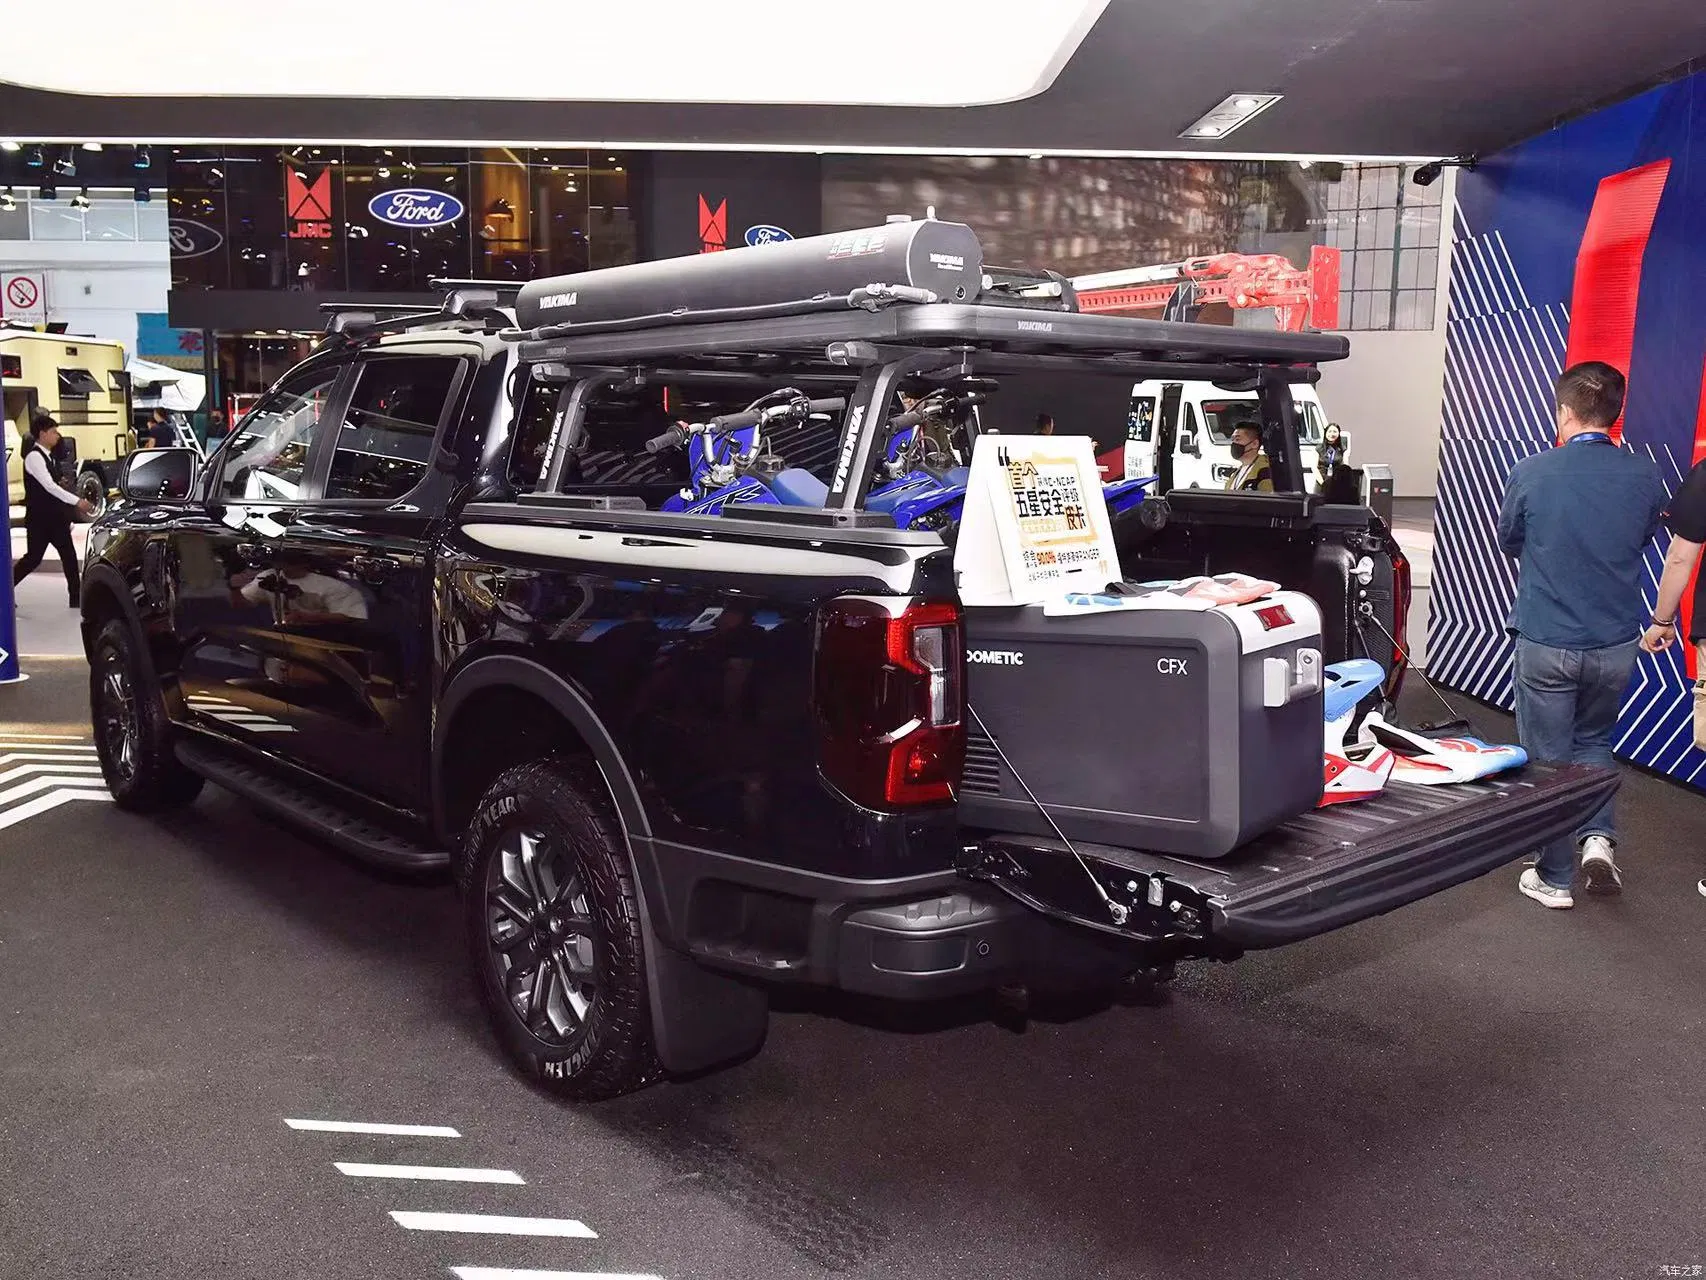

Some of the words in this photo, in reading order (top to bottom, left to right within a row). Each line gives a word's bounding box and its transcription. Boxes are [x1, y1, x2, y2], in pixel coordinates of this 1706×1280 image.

[386, 192, 446, 221] Ford
[289, 222, 332, 238] JMC
[539, 291, 578, 309] YAKIMA
[1017, 320, 1053, 332] YAKIMA
[539, 411, 564, 480] YAKIMA
[833, 405, 865, 493] YAKIMA
[1156, 657, 1188, 676] CFX
